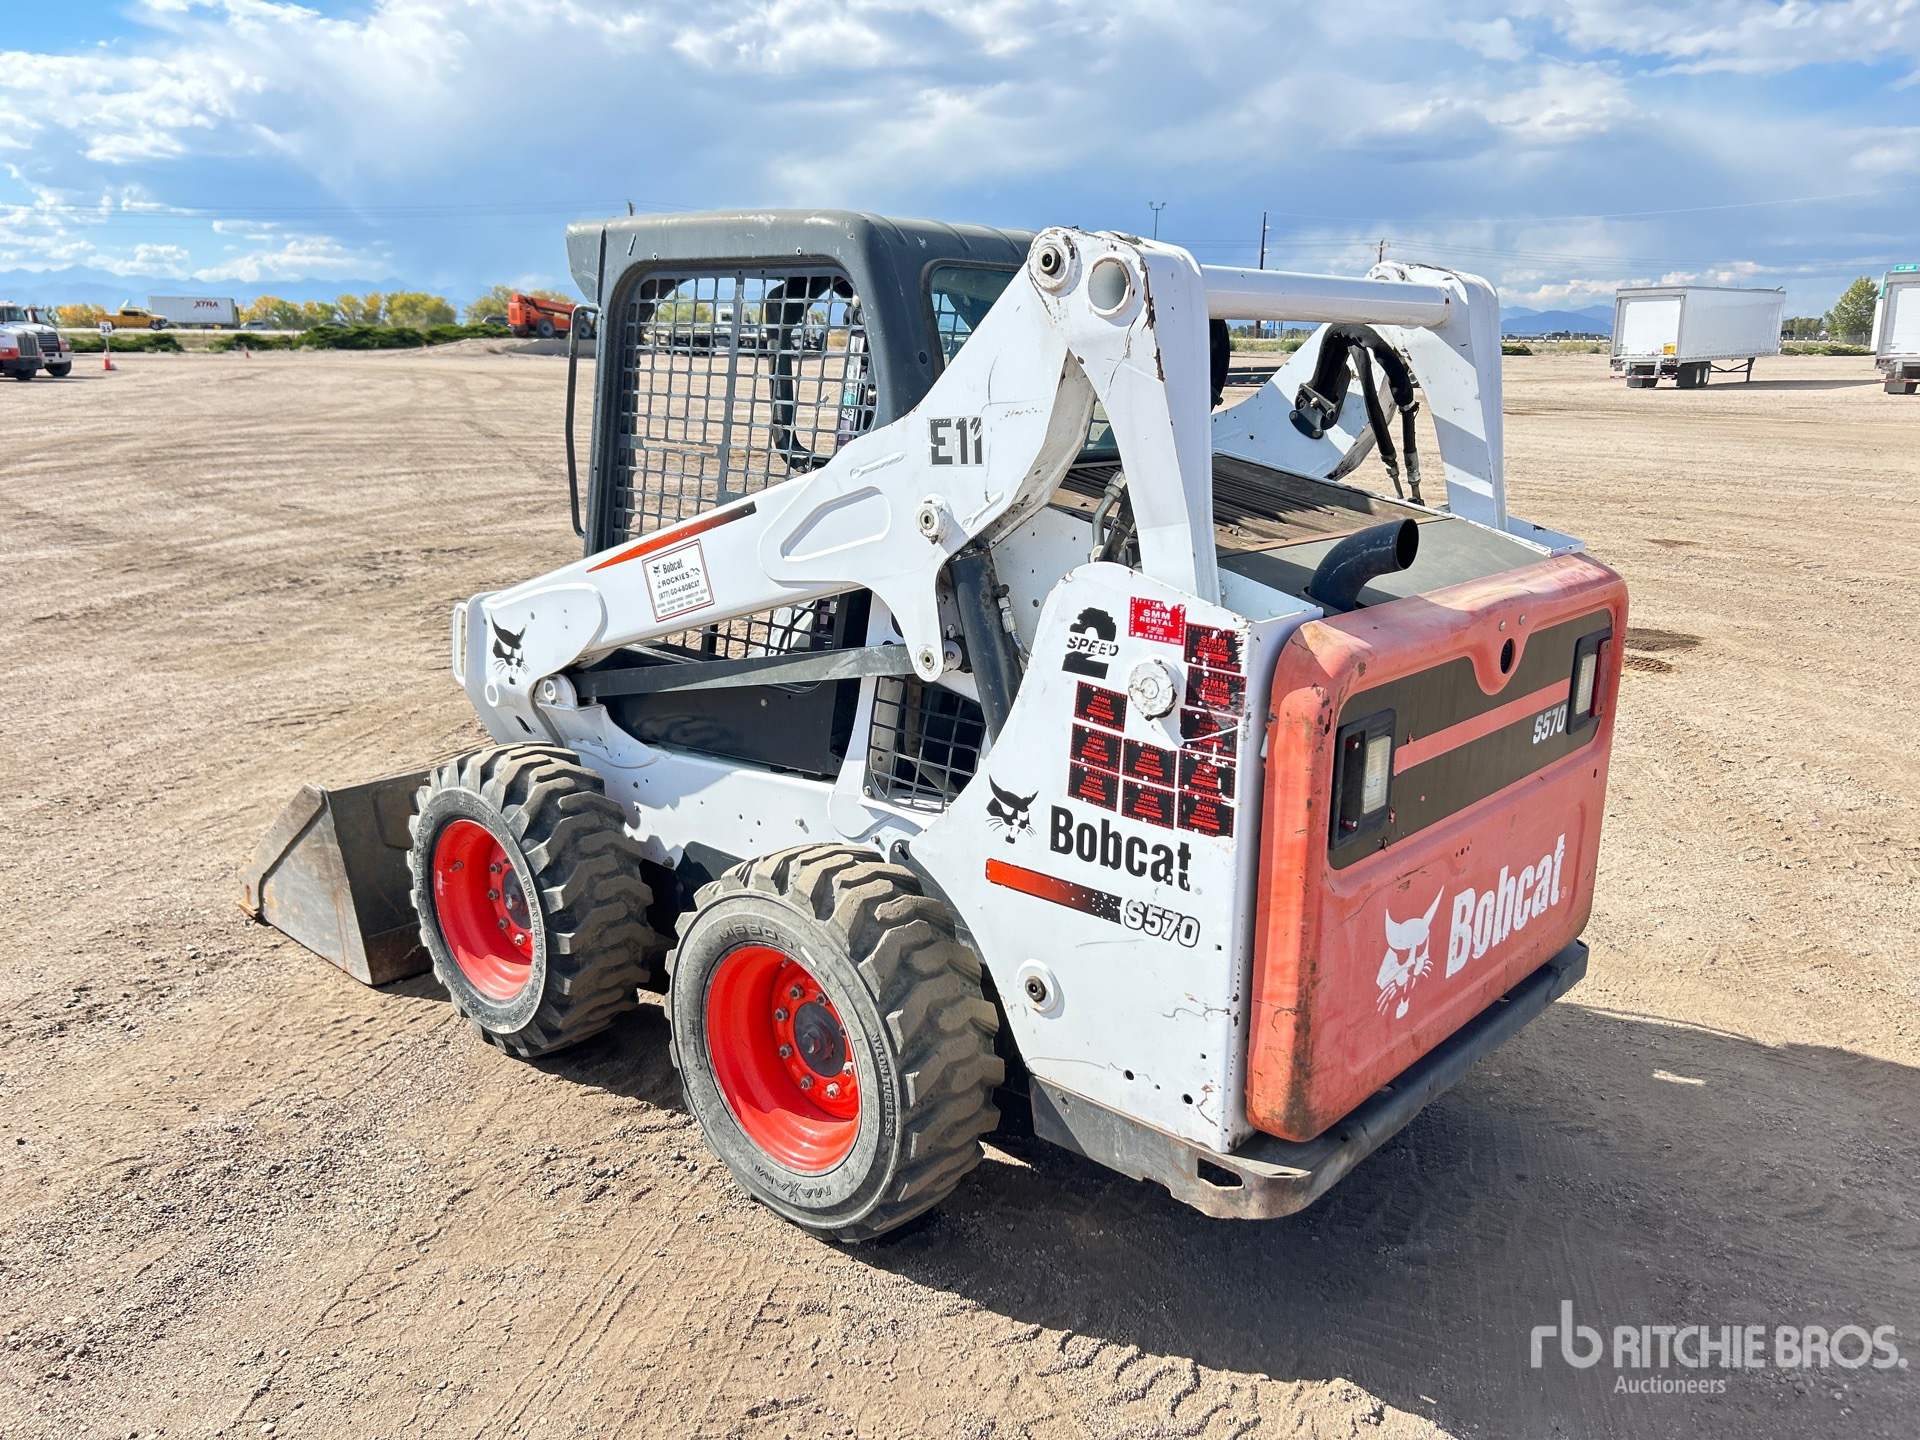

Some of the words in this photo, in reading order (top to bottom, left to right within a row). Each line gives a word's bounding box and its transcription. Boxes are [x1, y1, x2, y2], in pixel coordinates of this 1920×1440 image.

[194, 300, 219, 308] XTRA
[930, 417, 982, 465] E11
[662, 558, 683, 574] Bobcat
[661, 571, 690, 587] ROCKIES
[1143, 609, 1170, 620] SMM
[1139, 616, 1173, 627] RENTAL
[1067, 636, 1119, 656] SPEED
[1201, 635, 1227, 646] SMM
[1093, 695, 1111, 705] SMM
[1533, 705, 1567, 745] S570
[1087, 737, 1105, 746] SMM
[1141, 752, 1159, 761] SMM
[1197, 763, 1217, 772] SMM
[1086, 775, 1102, 785] SMM
[1140, 793, 1158, 802] SMM
[1196, 804, 1216, 813] SMM
[1050, 805, 1192, 891] Bobcat
[1446, 834, 1566, 979] Bobcat
[1124, 899, 1200, 948] S570
[870, 1032, 889, 1075] NYLON
[882, 1075, 895, 1137] TUBELESS
